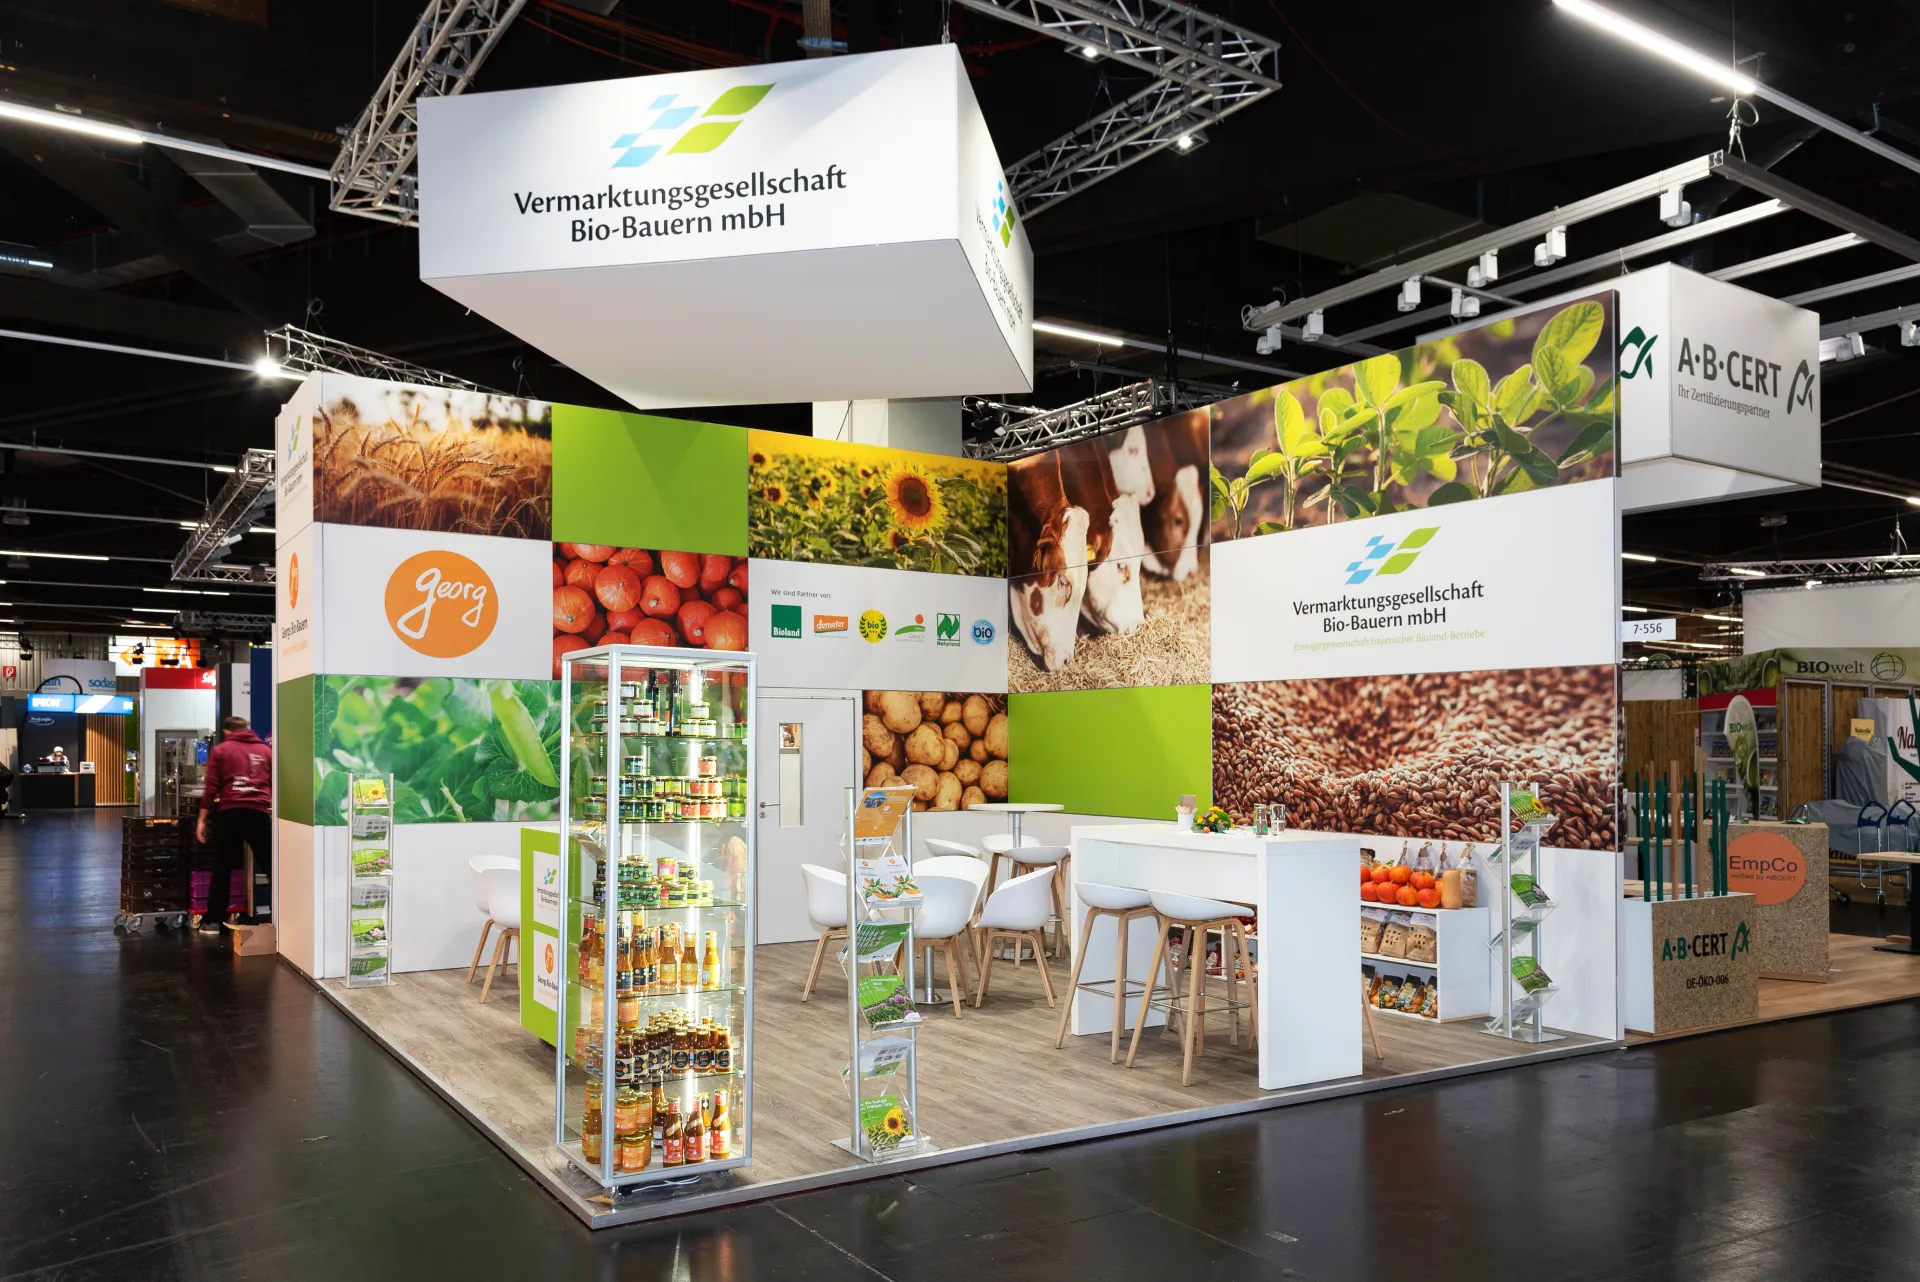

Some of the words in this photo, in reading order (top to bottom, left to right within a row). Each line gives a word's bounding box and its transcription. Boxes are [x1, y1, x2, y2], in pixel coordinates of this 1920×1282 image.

[514, 163, 847, 216] Vermarktungsgesellschaft
[570, 211, 713, 243] Bio-Bauern
[721, 203, 786, 232] mbH
[1678, 384, 1689, 399] Ihr
[1691, 388, 1770, 419] Zertifizierungspartner
[397, 567, 487, 639] georg
[797, 590, 818, 598] Partner
[1293, 580, 1484, 616] Vermarktungsgesellschaft
[816, 619, 845, 630] demeter
[867, 620, 880, 629] bio
[1323, 614, 1403, 633] Bio-Bauern
[1407, 607, 1446, 626] mbH
[1633, 623, 1663, 635] 7-556
[773, 627, 800, 637] Bioland
[1293, 636, 1370, 652] Erzeugergemeinschaft
[1416, 629, 1486, 643] Bioland-Betriebe
[1796, 660, 1865, 674] BIOwelt
[1897, 725, 1918, 750] Na
[1729, 855, 1798, 874] EmpCo
[1730, 872, 1755, 880] verified
[1755, 873, 1764, 881] by
[1686, 974, 1729, 990] DE-ÖKO-006
